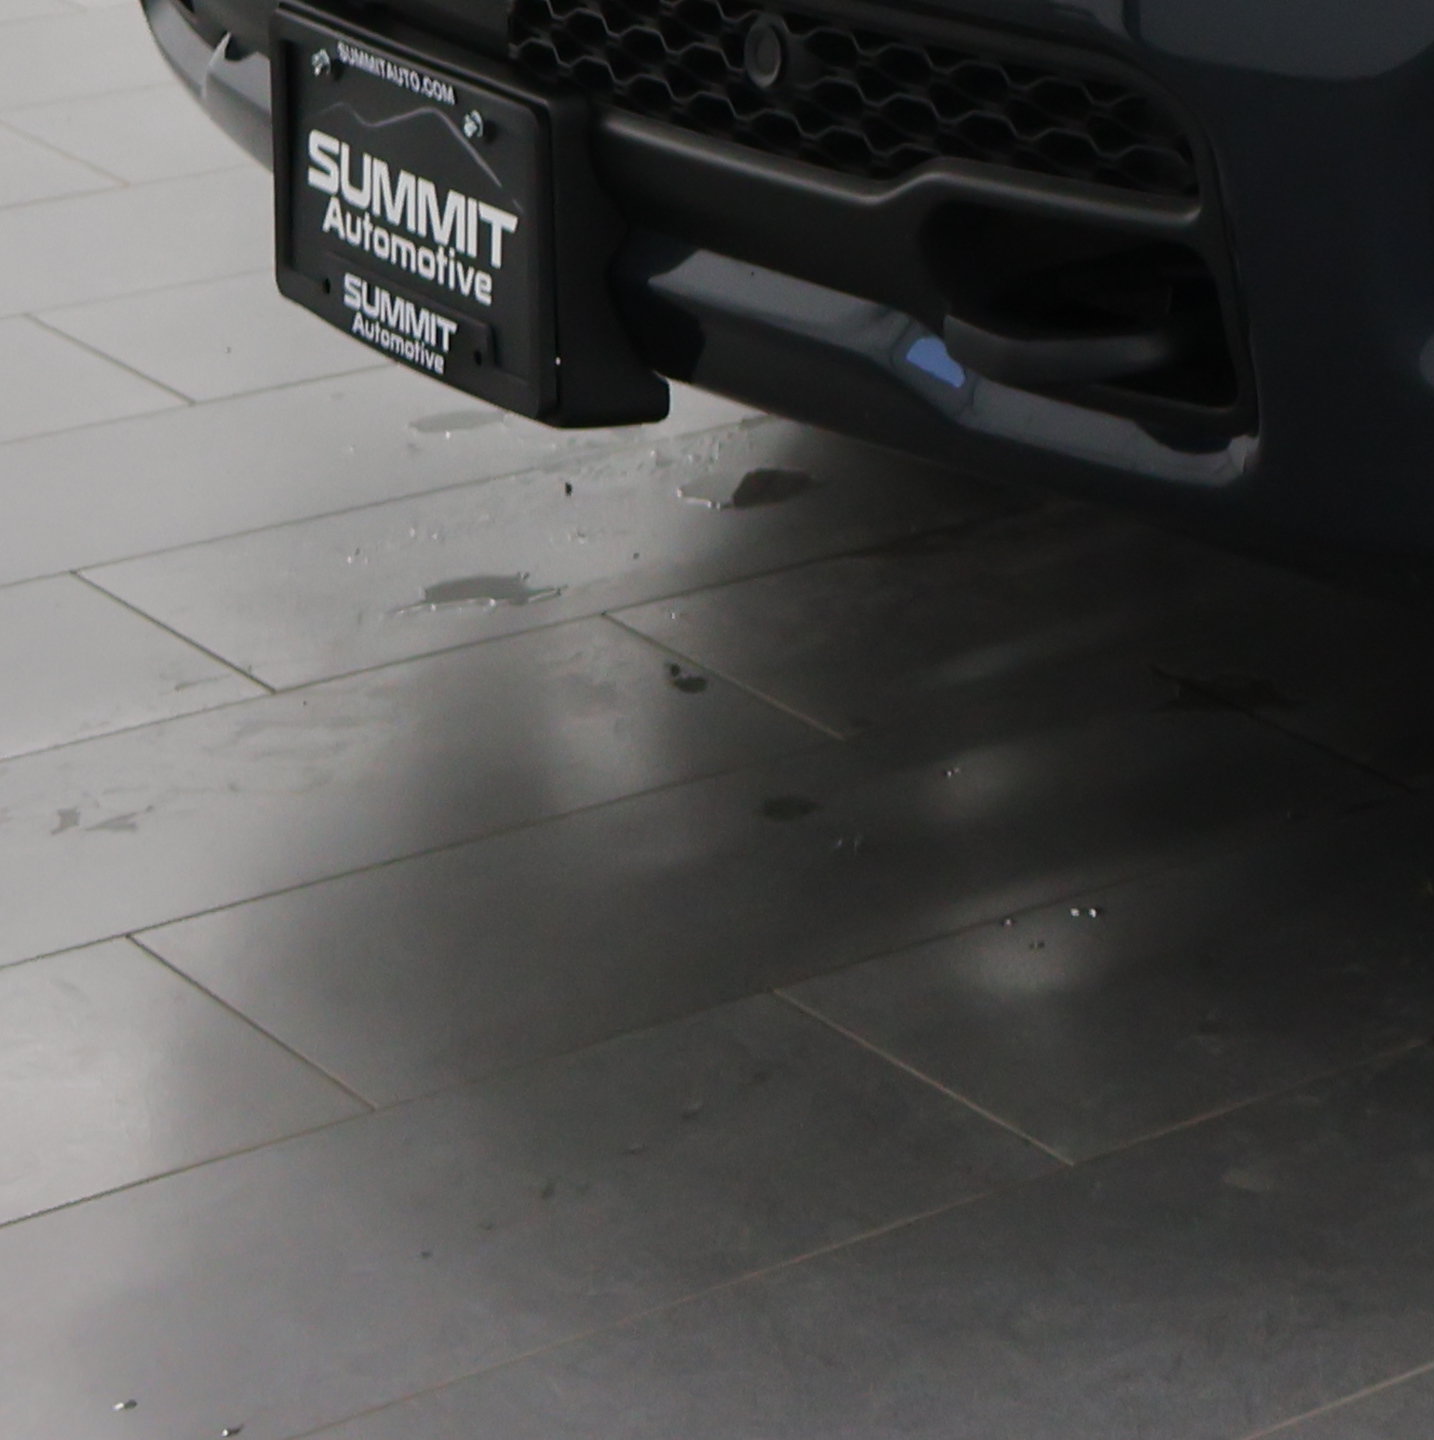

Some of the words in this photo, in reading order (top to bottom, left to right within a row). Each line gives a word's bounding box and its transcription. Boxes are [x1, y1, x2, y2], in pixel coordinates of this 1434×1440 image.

[308, 129, 518, 269] SUMMIT
[322, 196, 493, 306] Automotive
[344, 272, 458, 353] SUMMIT
[352, 311, 445, 374] Automotive
